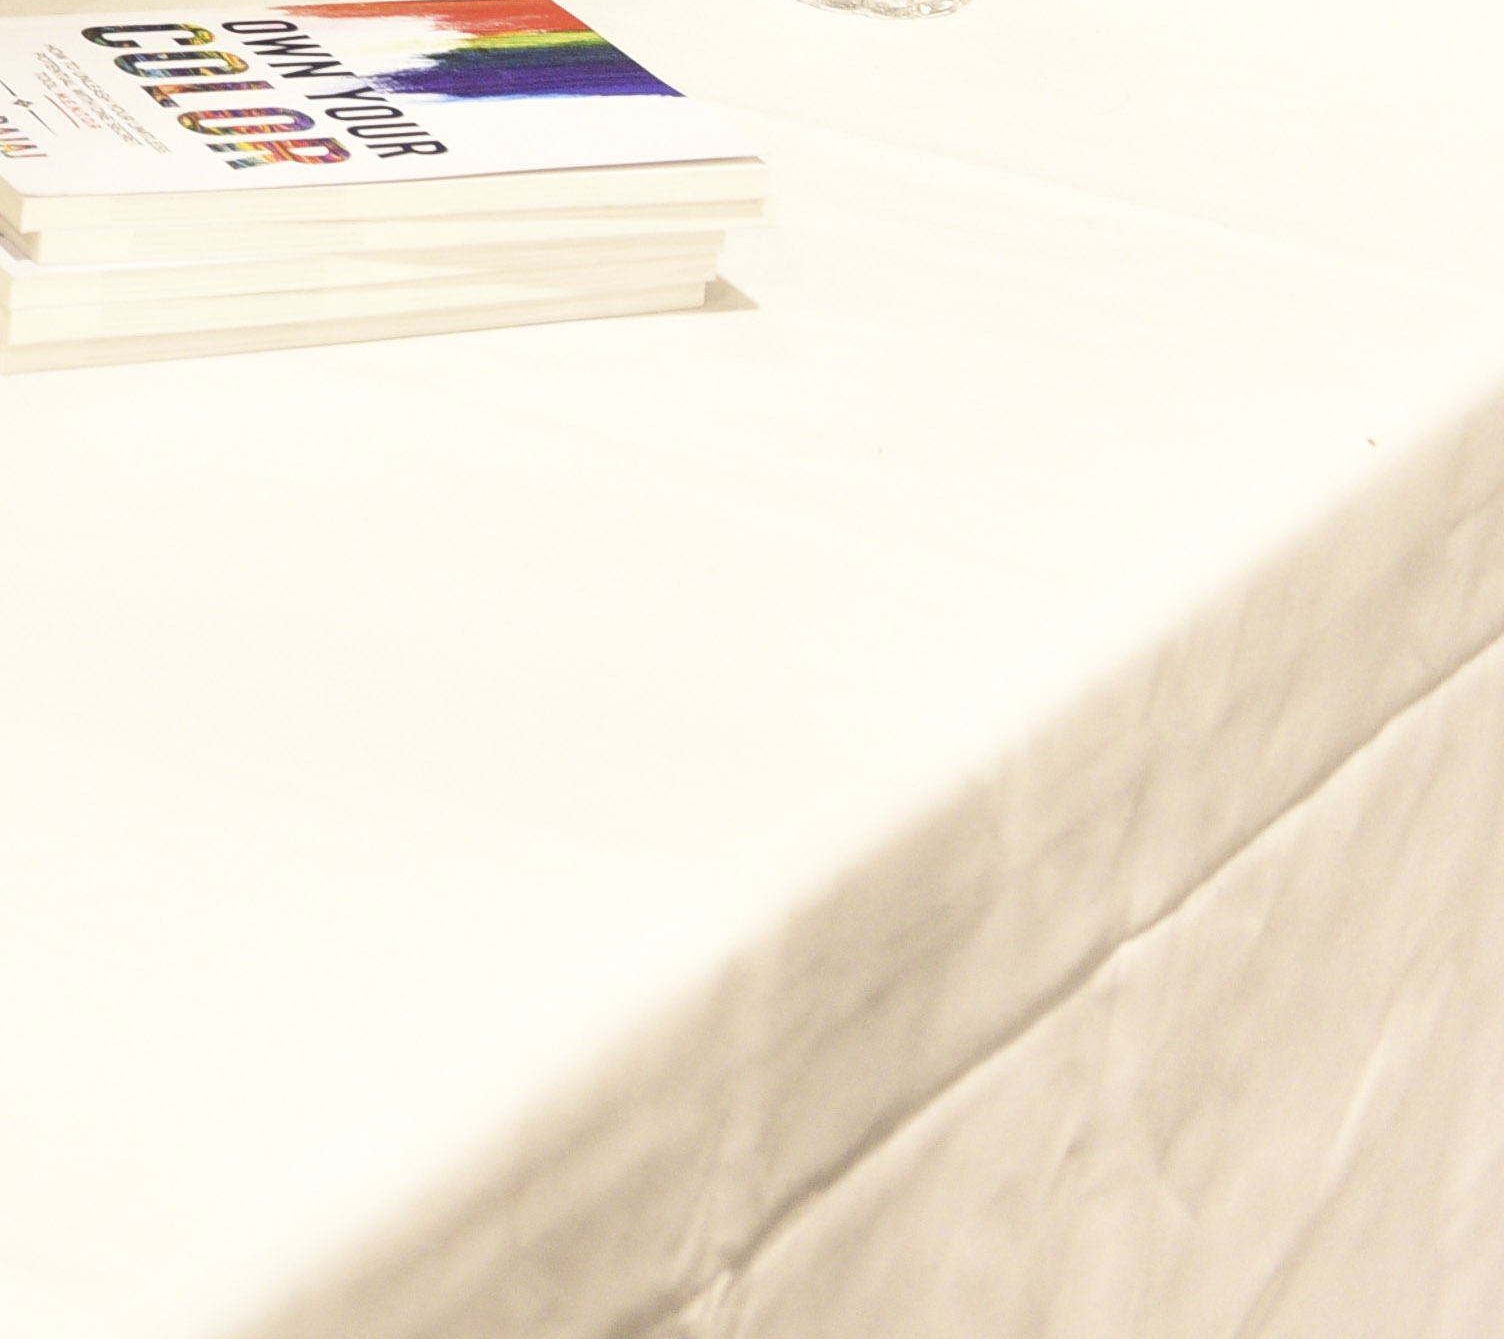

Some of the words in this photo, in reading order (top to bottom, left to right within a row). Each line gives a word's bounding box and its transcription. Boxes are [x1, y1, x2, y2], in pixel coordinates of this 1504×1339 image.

[80, 22, 352, 172] COLOR
[221, 18, 358, 80] OWN
[304, 83, 450, 160] YOUR
